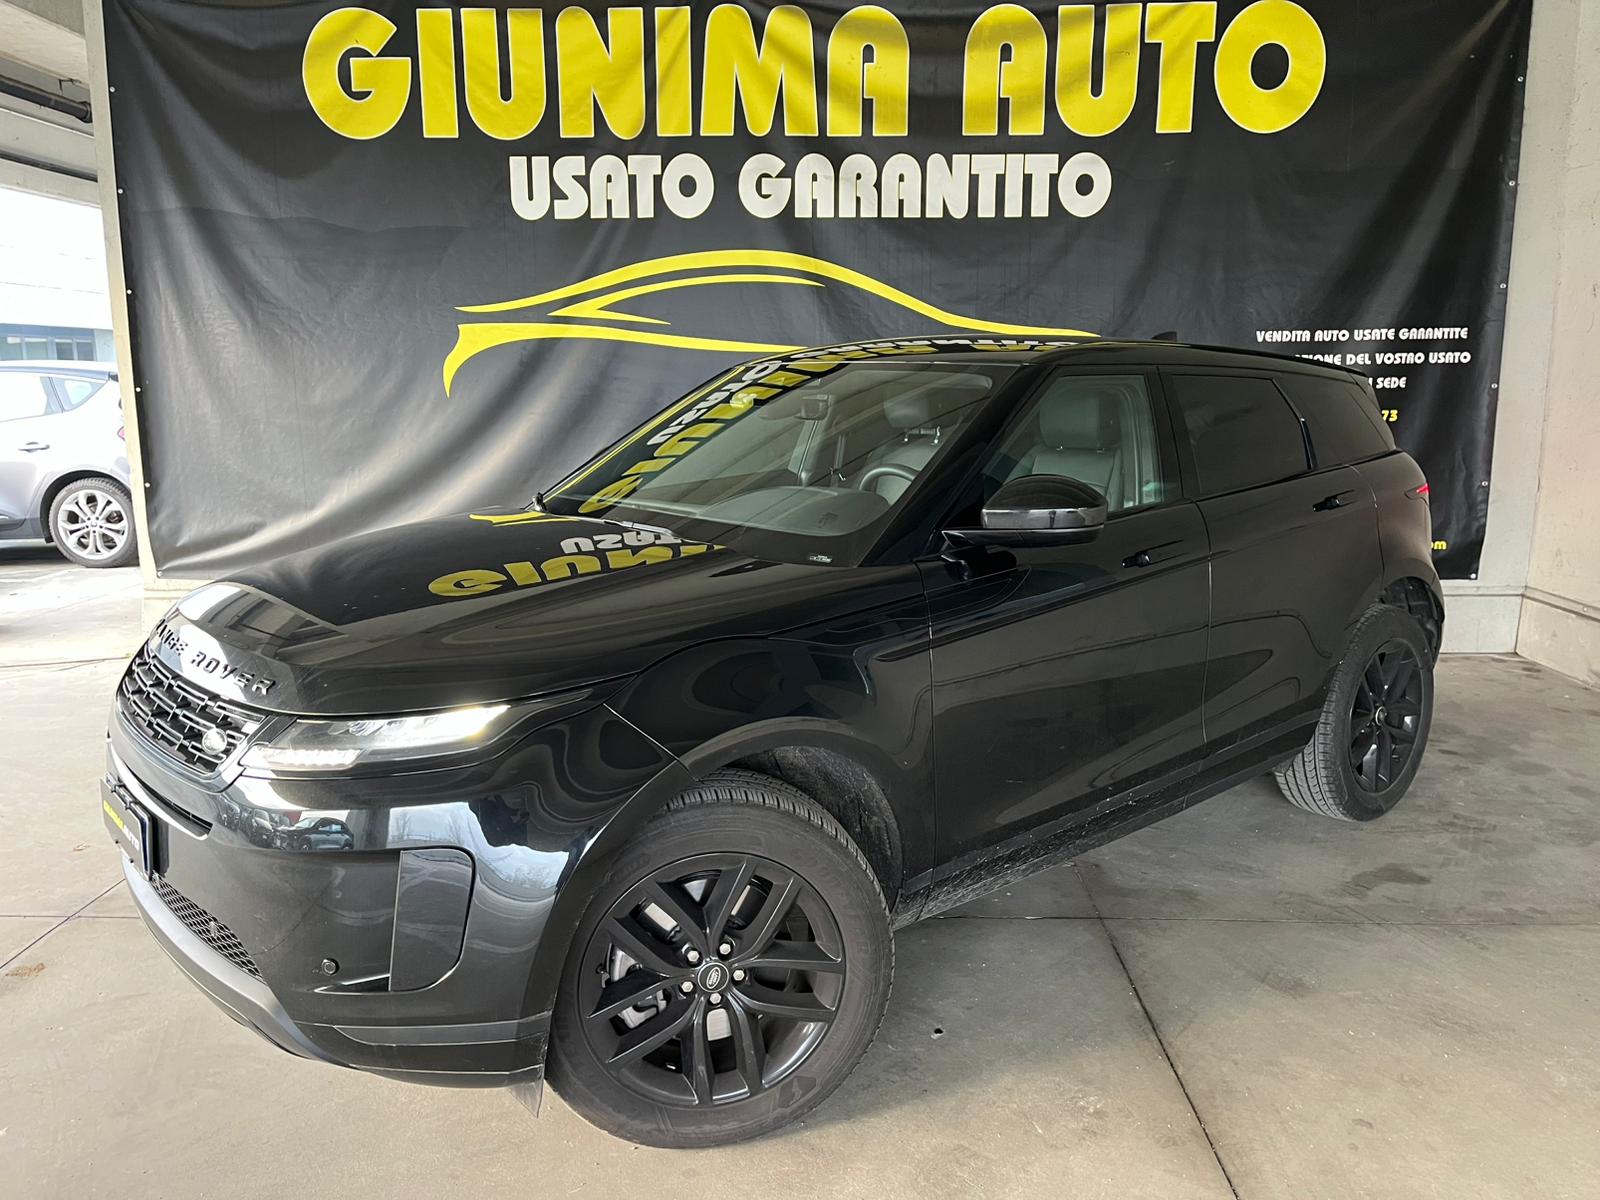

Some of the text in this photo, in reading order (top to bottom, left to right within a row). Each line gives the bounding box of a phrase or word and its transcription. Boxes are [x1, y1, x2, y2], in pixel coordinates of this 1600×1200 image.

[302, 0, 1326, 140] GIUNIMA AUTO
[509, 152, 1112, 220] USATO GARANTITO
[1256, 327, 1469, 342] VENDITA AUTO USATE GARANTITE
[1346, 354, 1371, 366] DEL
[1375, 353, 1425, 365] VOSTRO
[1428, 352, 1471, 364] USATO
[1376, 377, 1407, 389] SEDE
[191, 651, 276, 696] ROVER
